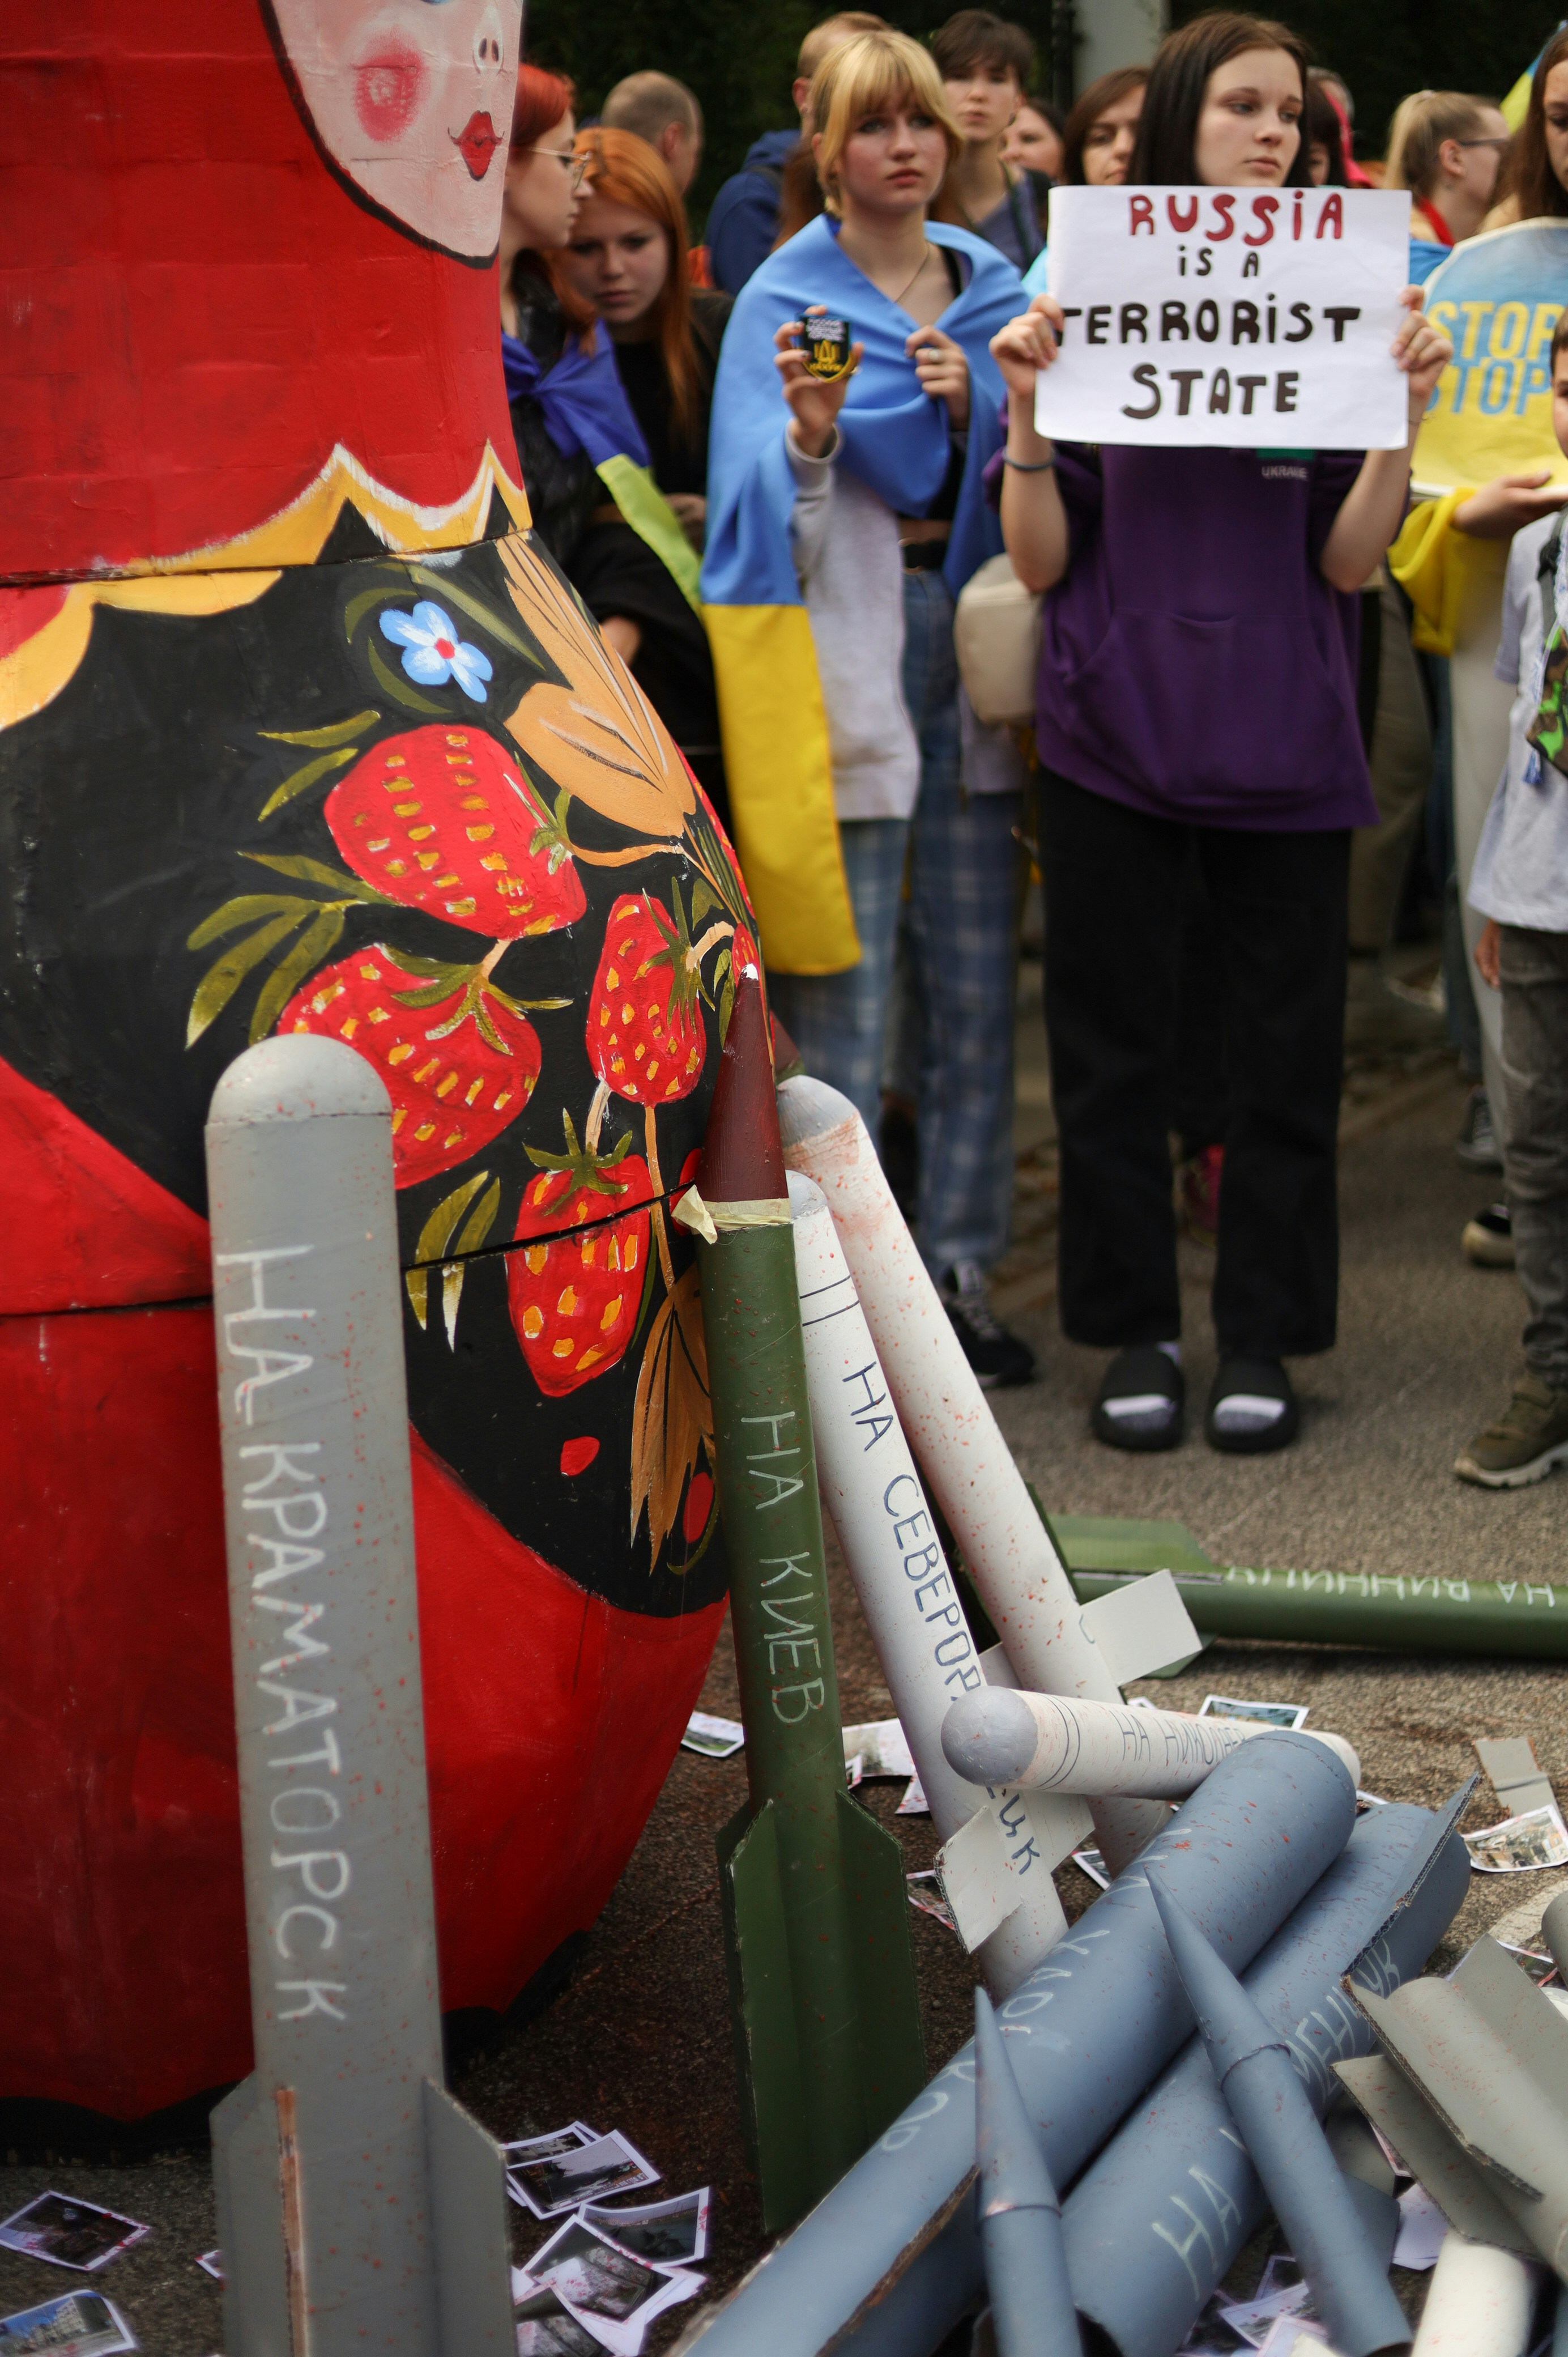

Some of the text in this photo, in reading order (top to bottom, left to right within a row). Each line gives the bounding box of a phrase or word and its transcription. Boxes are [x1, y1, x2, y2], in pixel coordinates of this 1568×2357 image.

[1241, 251, 1260, 278] A
[1425, 300, 1565, 361] STOP
[1121, 363, 1299, 420] STATE
[741, 1411, 825, 1723] НА КИЕВ
[842, 1361, 1040, 1875] НА СЕВЕРОДЦК
[238, 1441, 351, 2020] КРАМАТОРСК
[1110, 1710, 1151, 1762] НА
[1151, 2165, 1243, 2302] НА
